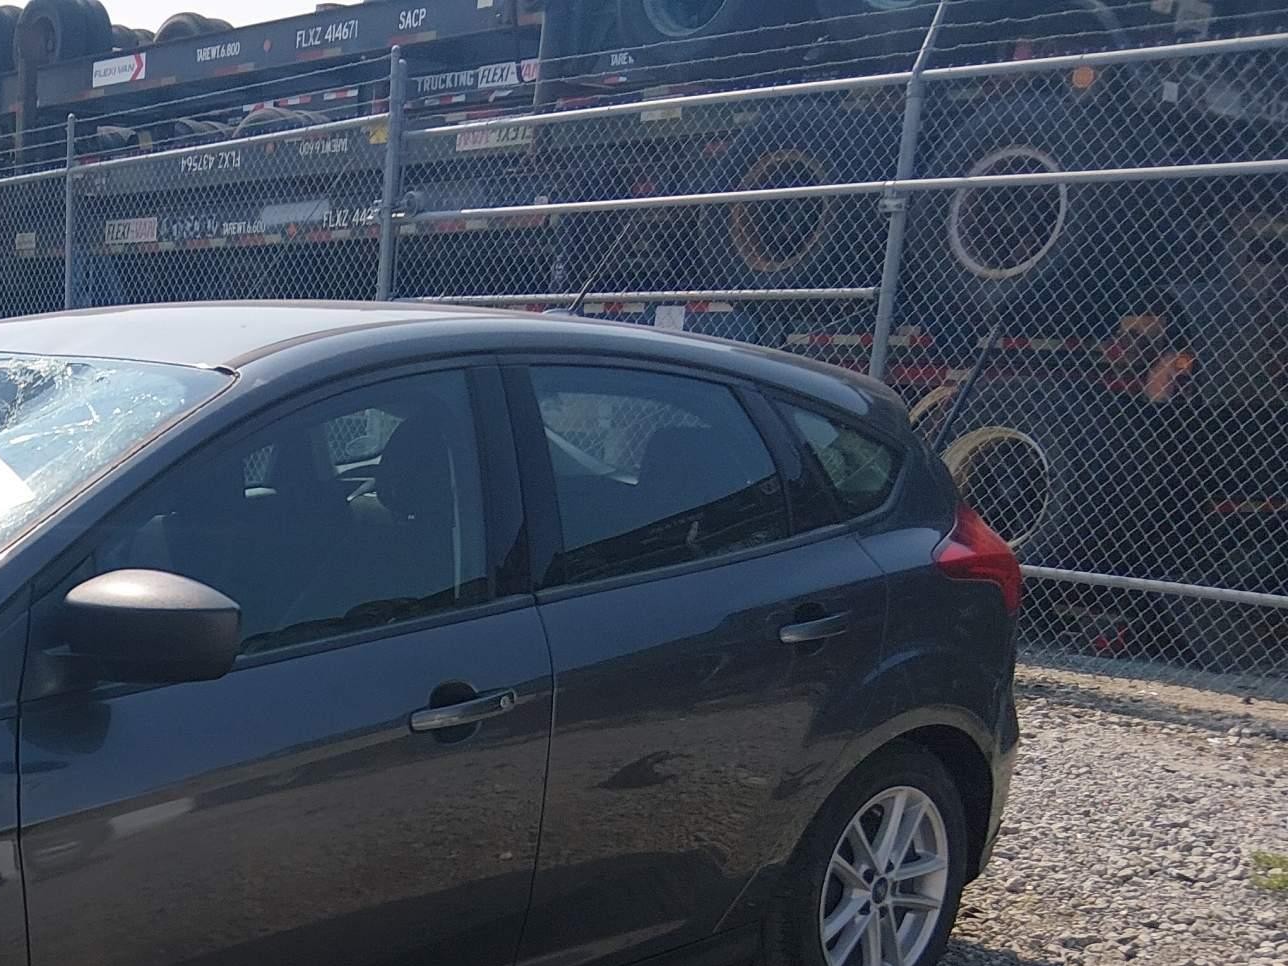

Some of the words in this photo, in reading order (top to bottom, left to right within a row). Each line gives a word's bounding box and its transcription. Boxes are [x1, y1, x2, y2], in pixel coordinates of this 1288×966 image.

[398, 8, 427, 30] SACP
[296, 27, 322, 48] FLXZ
[324, 19, 359, 43] 414671
[417, 70, 474, 92] TRUCKING
[322, 209, 349, 229] FLXZ
